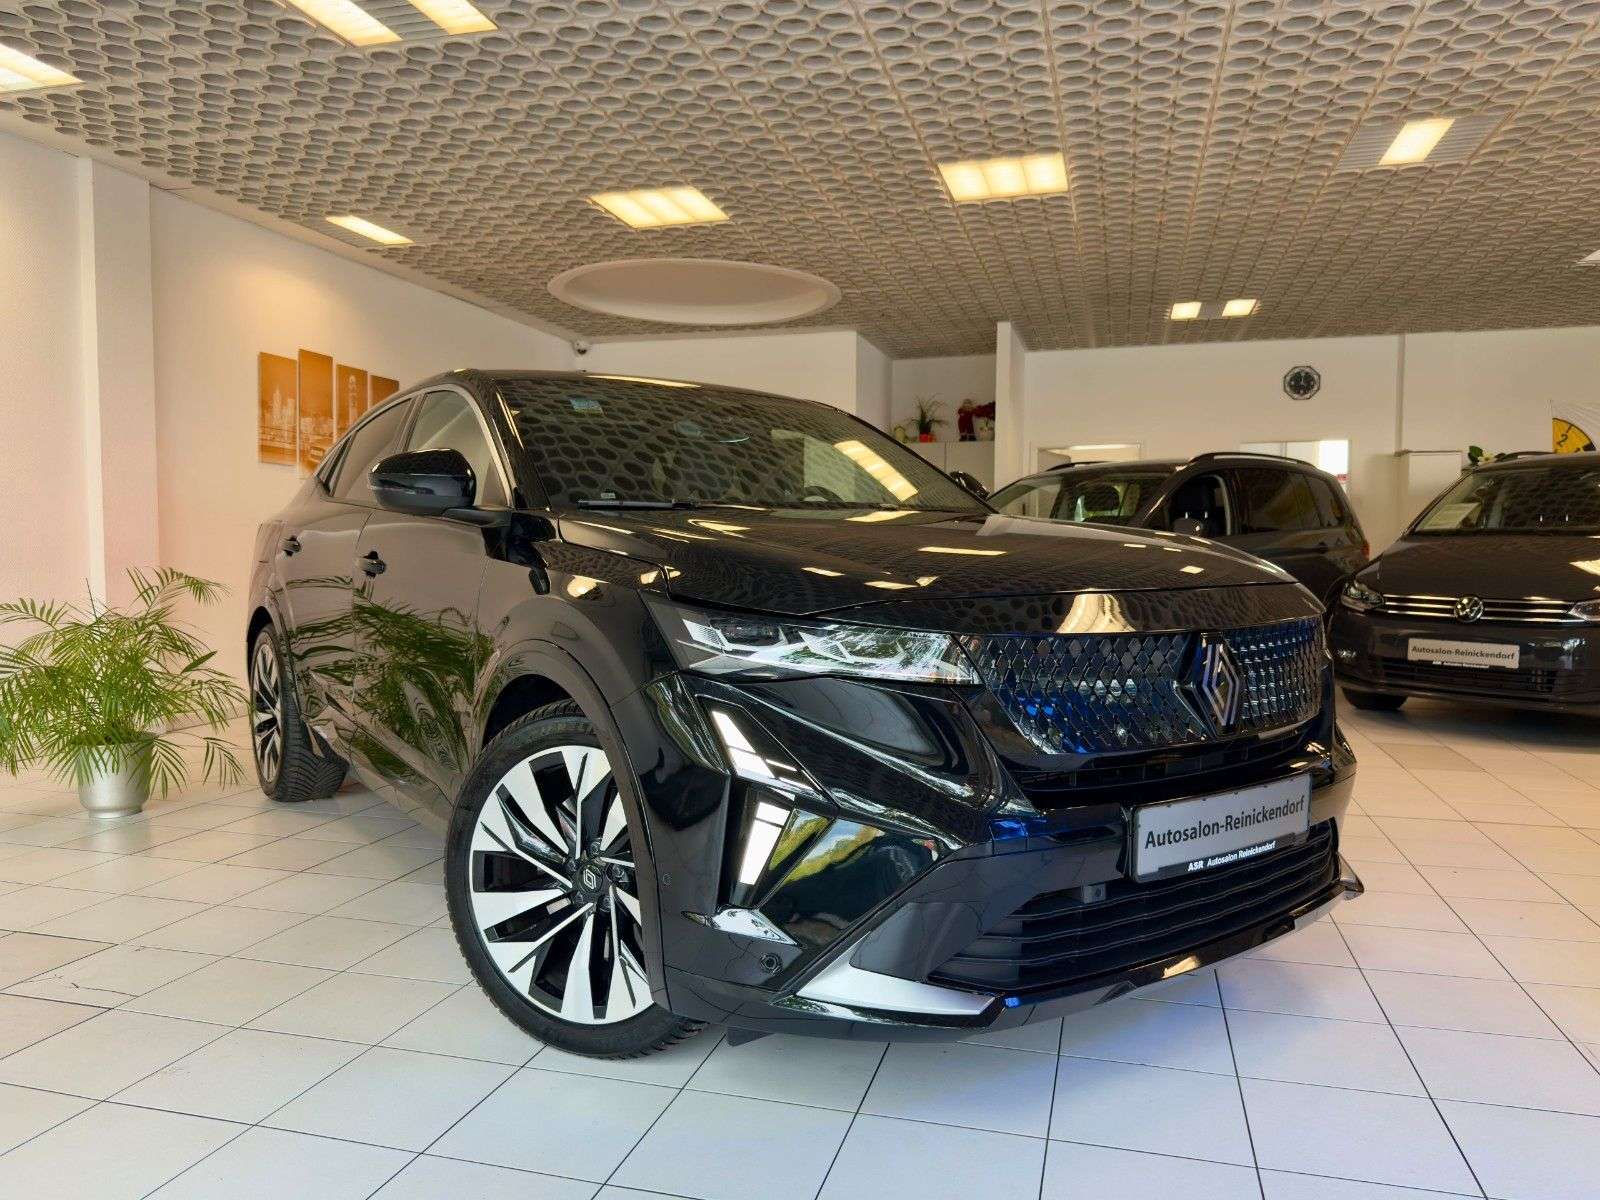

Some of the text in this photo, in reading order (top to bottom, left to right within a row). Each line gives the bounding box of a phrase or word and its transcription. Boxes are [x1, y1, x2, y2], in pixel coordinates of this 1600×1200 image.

[1411, 645, 1516, 661] Autosalon-Reinickendorf
[1144, 795, 1305, 849] Autosalon-Reinickendorf
[1187, 840, 1276, 872] ASR Autosalon Reinickendorf
